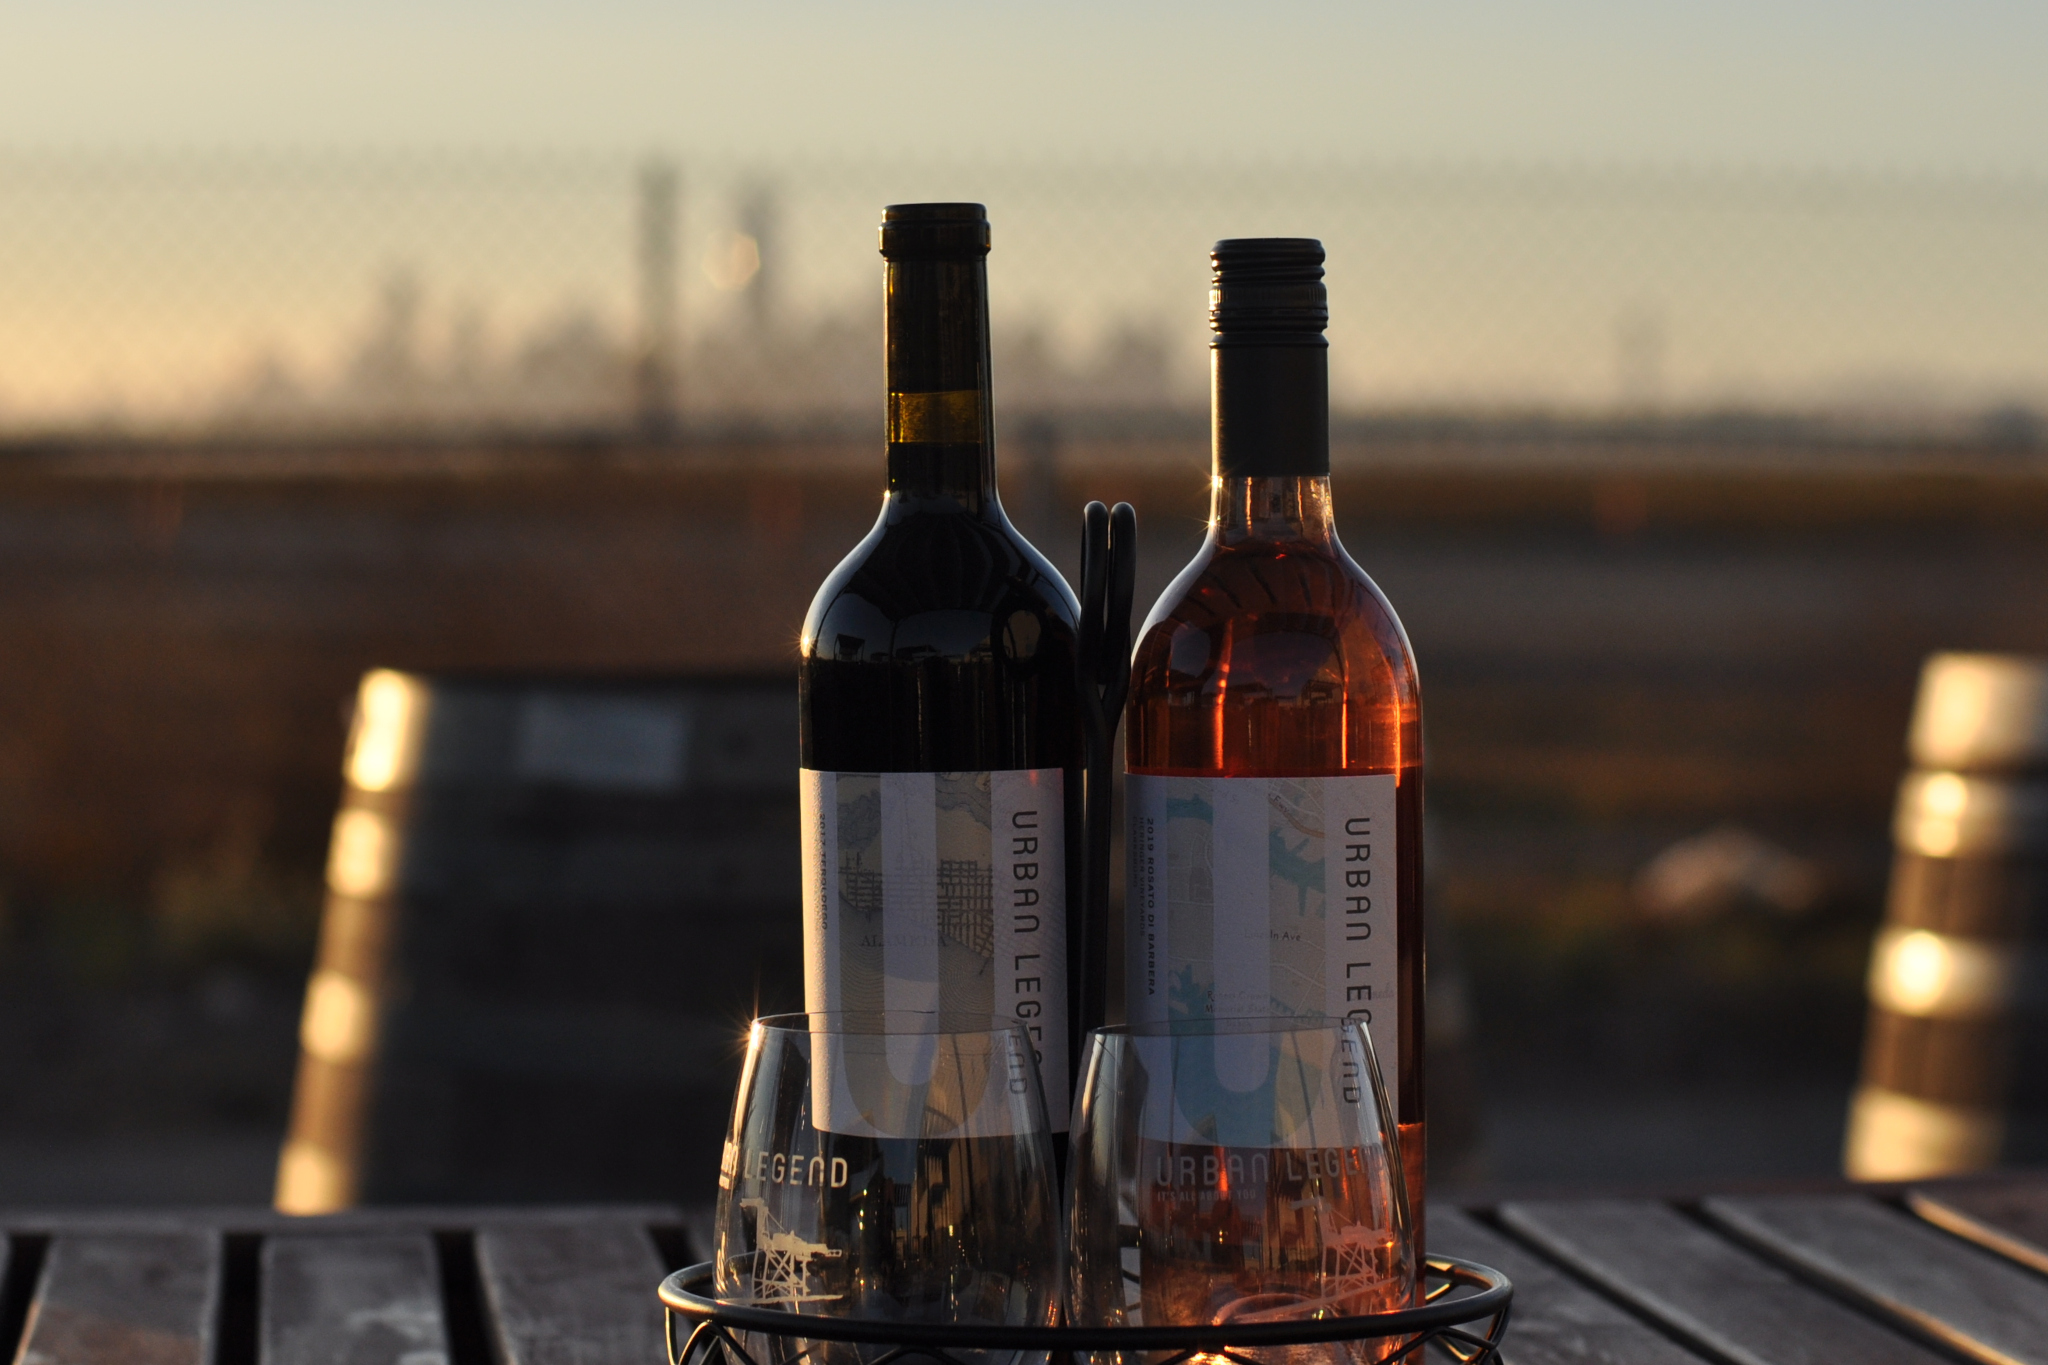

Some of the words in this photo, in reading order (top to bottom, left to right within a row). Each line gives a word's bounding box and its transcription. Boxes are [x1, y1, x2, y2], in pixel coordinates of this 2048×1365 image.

[1011, 810, 1041, 934] URBAN
[1147, 857, 1155, 909] ROSATO
[1344, 817, 1372, 941] URBAN
[1147, 914, 1155, 927] DI
[1281, 930, 1301, 942] Ave
[1147, 933, 1156, 996] BARBERA
[743, 1147, 849, 1189] LEGEND
[1156, 1152, 1269, 1187] URBAN
[1157, 1190, 1177, 1202] IT'S
[1179, 1190, 1196, 1201] ALL
[1236, 1188, 1256, 1200] YOU
